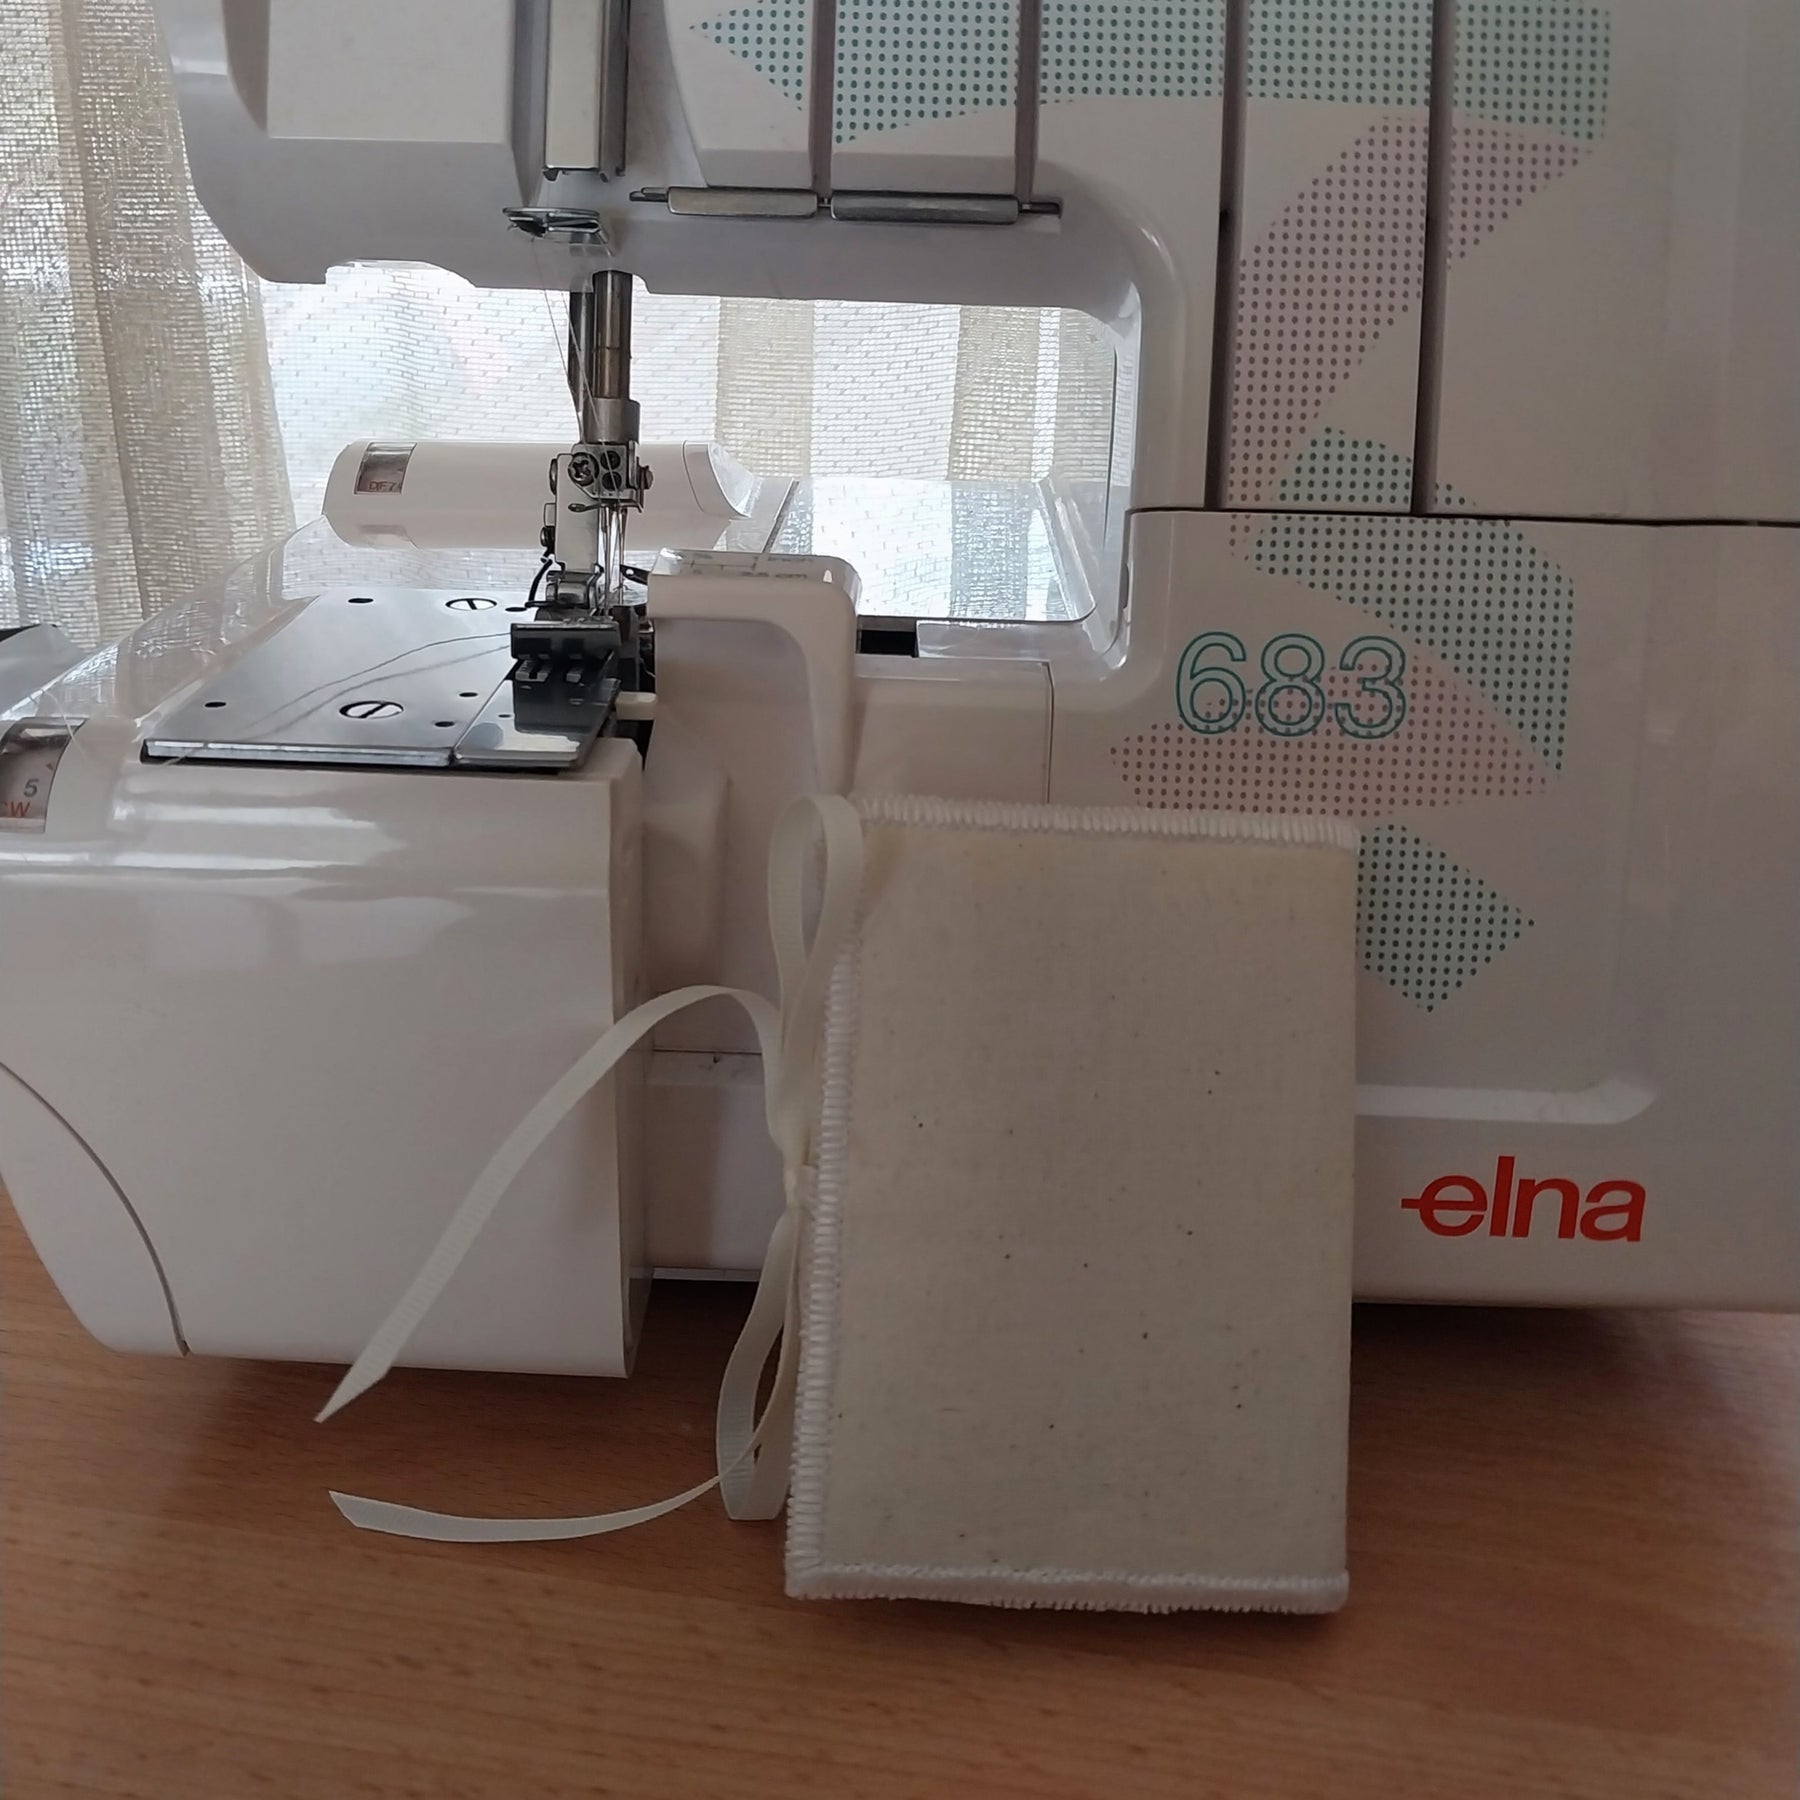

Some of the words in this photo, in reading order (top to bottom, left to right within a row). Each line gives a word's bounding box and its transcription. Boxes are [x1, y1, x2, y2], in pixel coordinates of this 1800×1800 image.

[1176, 631, 1406, 739] 683
[3, 801, 31, 818] W
[23, 778, 40, 797] 5
[1401, 1155, 1646, 1242] elna
